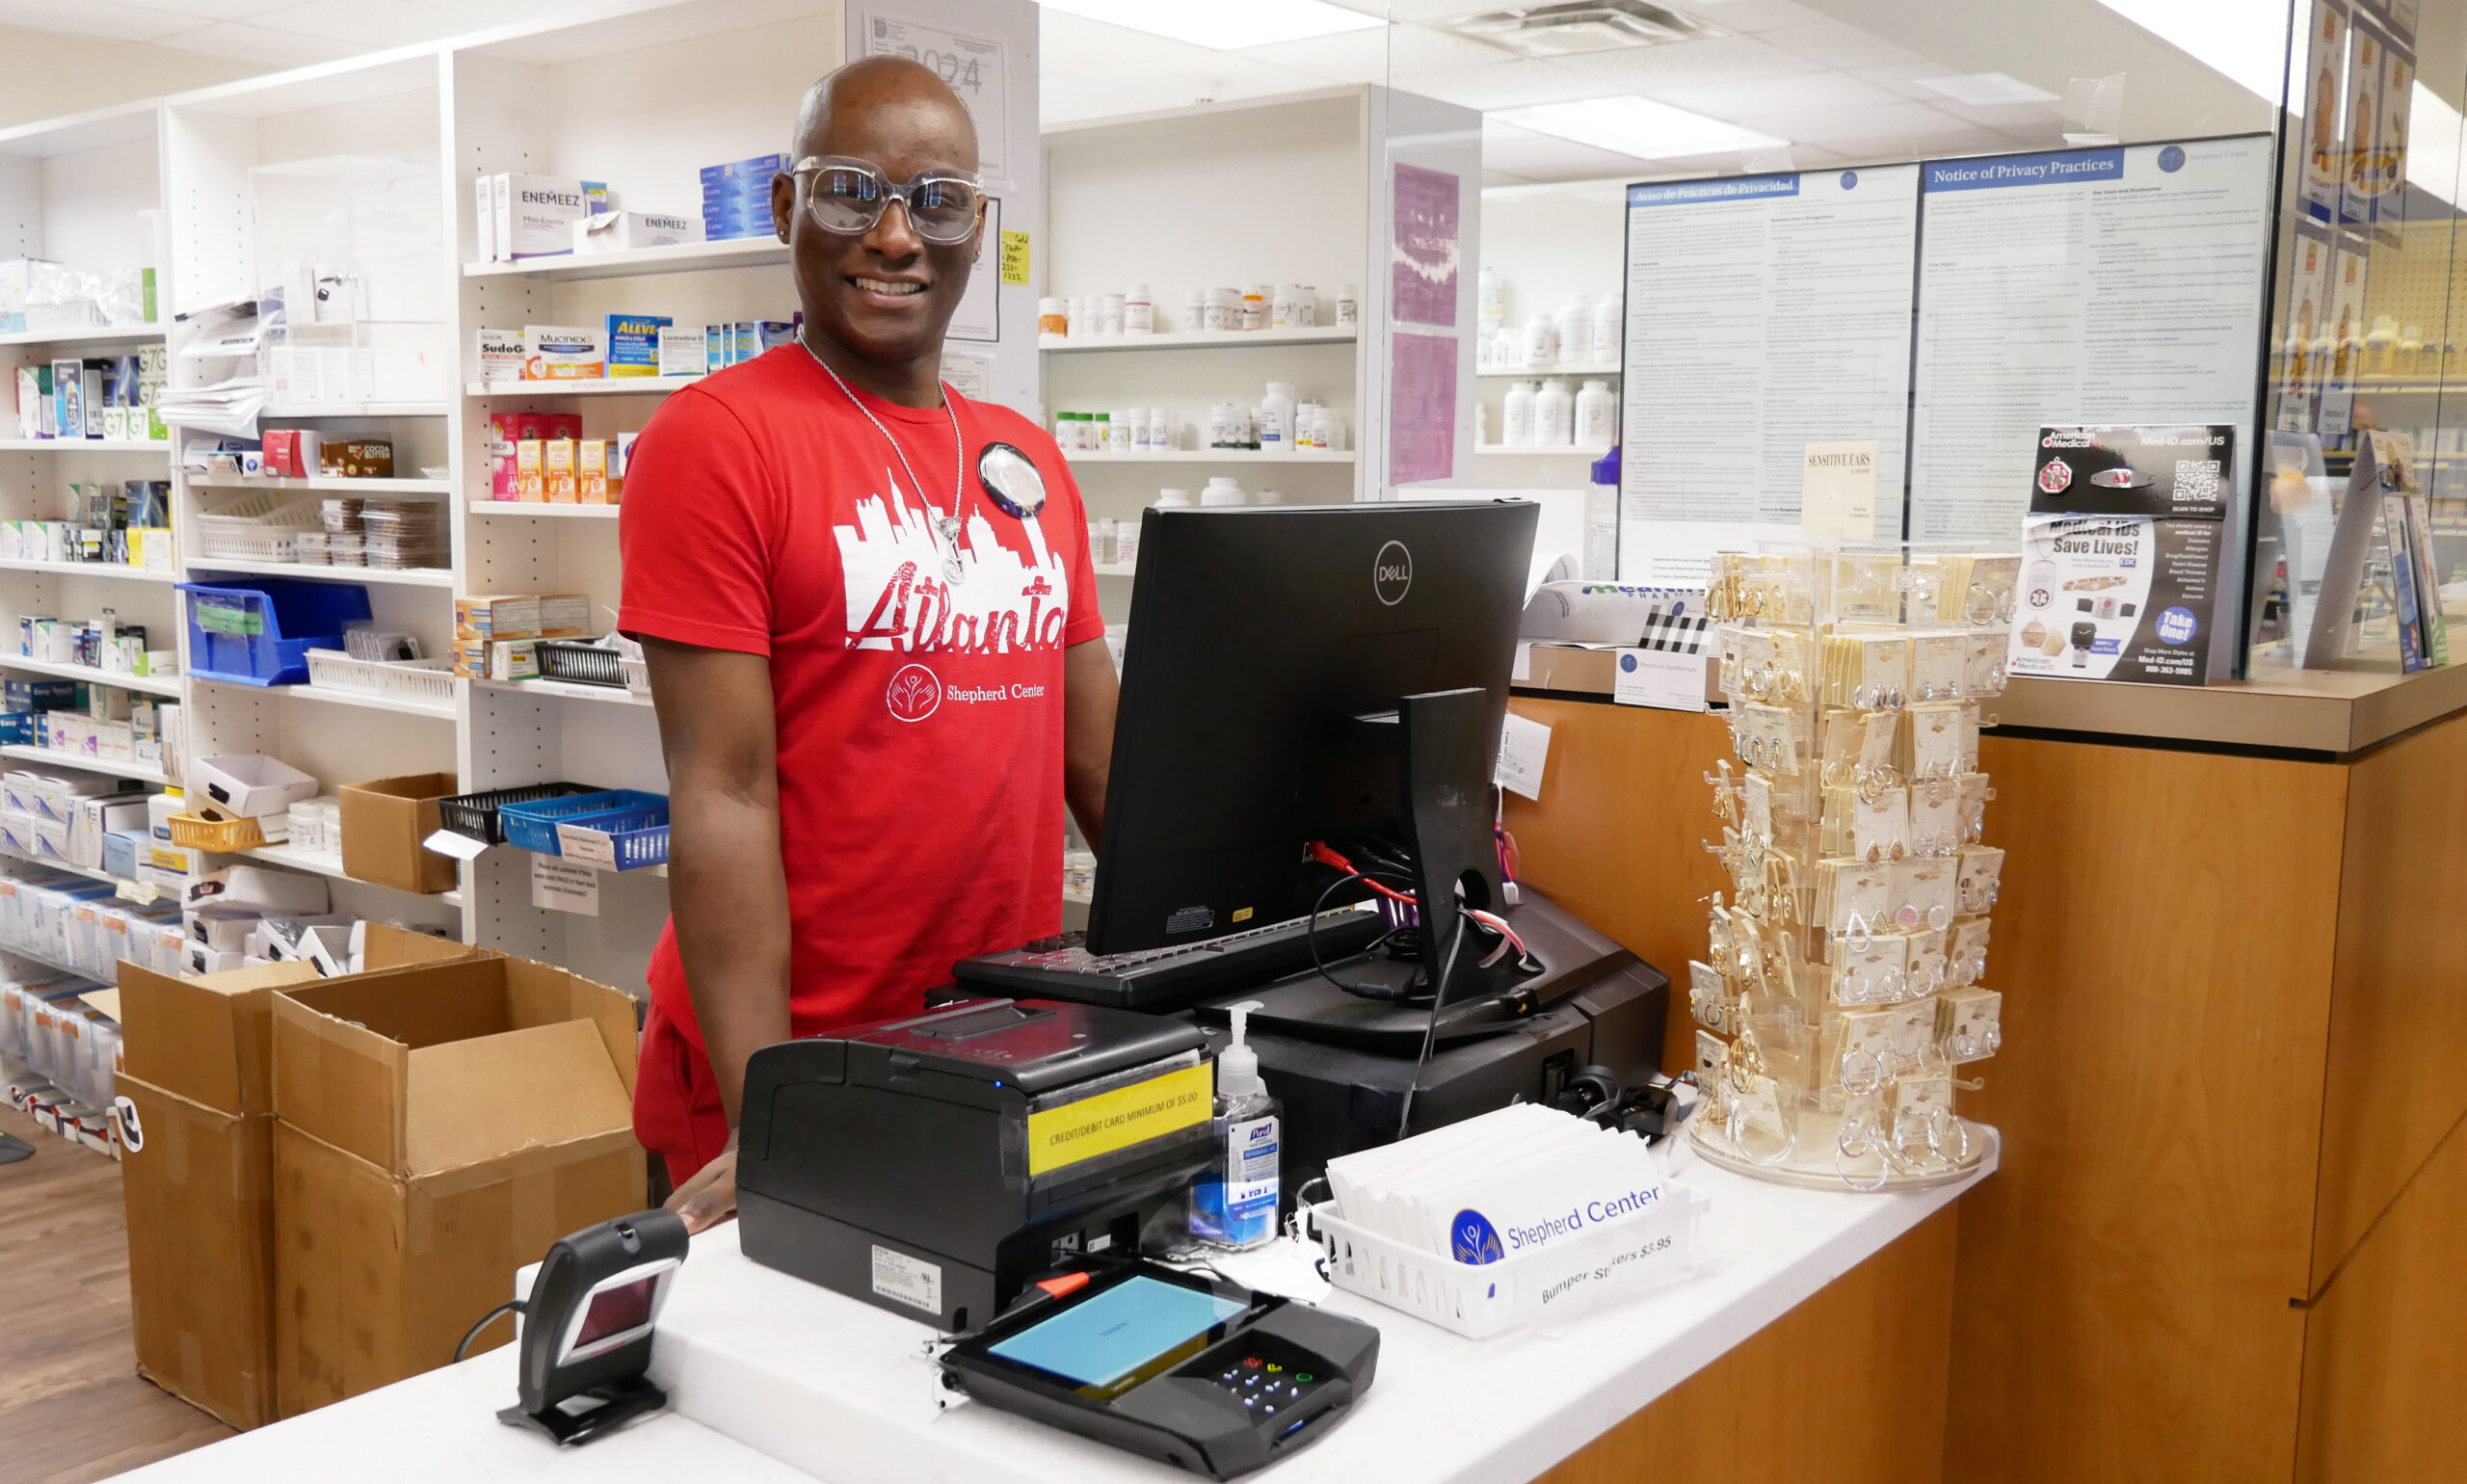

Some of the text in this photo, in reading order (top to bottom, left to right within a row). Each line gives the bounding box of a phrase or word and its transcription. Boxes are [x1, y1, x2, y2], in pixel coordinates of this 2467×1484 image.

[1934, 157, 2114, 183] Notice of Privacy Practices
[1636, 190, 1660, 202] Aviso
[1661, 188, 1676, 200] de
[1721, 182, 1737, 196] de
[1738, 178, 1793, 196] Privacidad
[521, 191, 580, 207] ENEMEEZ
[646, 218, 687, 230] ENEMEEZ
[541, 334, 587, 344] Mucinex
[482, 343, 526, 354] SudoG
[104, 413, 123, 436] G7
[129, 412, 146, 436] G7
[2050, 432, 2095, 440] American
[2141, 437, 2225, 446] Med-ID.com/US
[1808, 453, 1870, 467] SENSITIVE EARS
[2053, 538, 2138, 555] Save Lives!
[1379, 565, 1408, 582] DELL
[845, 561, 1066, 650] Atlanta
[2163, 611, 2193, 628] Take
[2159, 624, 2190, 642] One!
[2137, 656, 2194, 666] Med-ID.com/US
[947, 683, 1045, 704] Shepherd Center
[1050, 1092, 1198, 1146] CREDIT/DEBIT CARD MINIMUM OF $5.00
[1508, 1184, 1660, 1250] Shepherd Center
[1542, 1271, 1589, 1305] Bumper
[1640, 1235, 1672, 1259] $3.95
